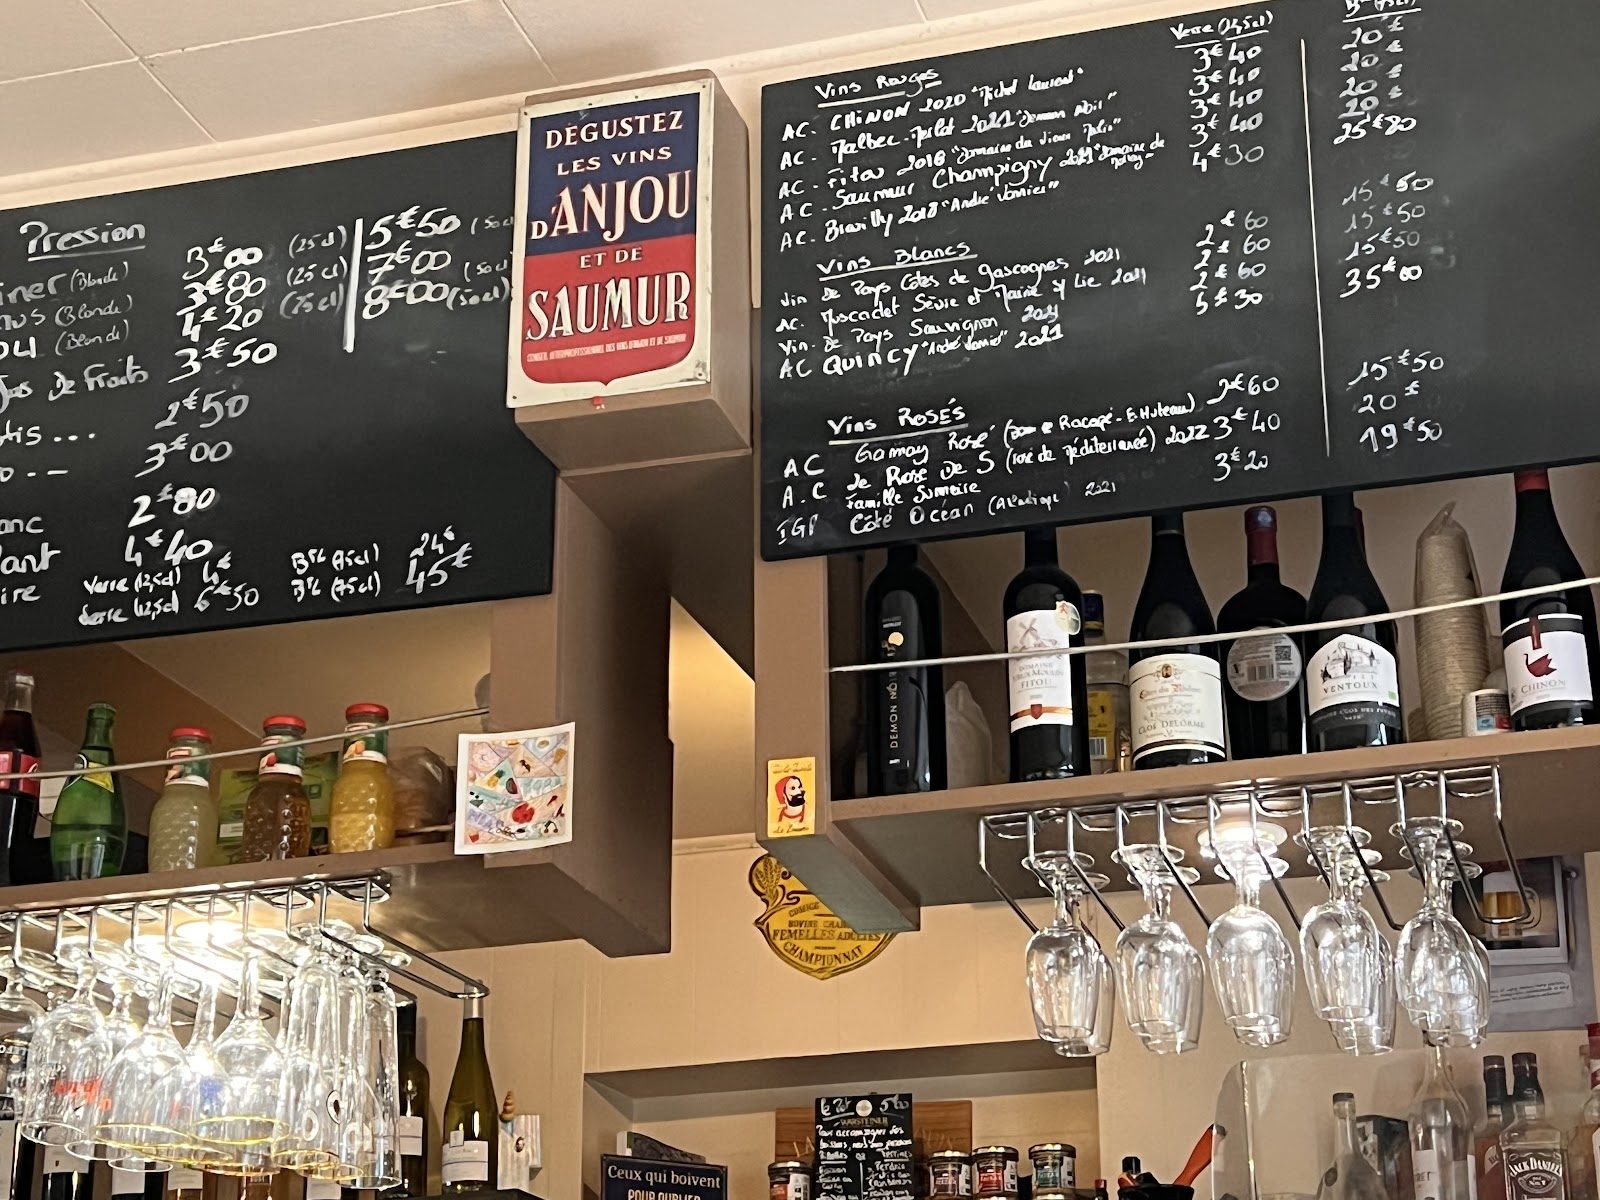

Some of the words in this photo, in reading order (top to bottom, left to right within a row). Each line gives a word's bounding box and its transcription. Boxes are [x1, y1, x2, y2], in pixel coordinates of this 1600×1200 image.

[815, 82, 861, 99] Vins
[919, 94, 966, 113] 2020
[545, 109, 684, 150] DÉGUSTEZ
[556, 152, 601, 176] LES
[611, 145, 673, 167] VINS
[832, 183, 915, 211] Saumur
[932, 155, 1053, 189] Champigny
[530, 169, 692, 243] D'ANJOU
[898, 202, 939, 225] 2018
[19, 220, 146, 255] Pression
[579, 251, 607, 269] ET
[615, 246, 644, 265] DE
[816, 255, 871, 275] Vins
[894, 241, 971, 266] Blancs
[1084, 247, 1121, 266] 2021
[525, 271, 692, 342] SAUMUR
[778, 358, 813, 380] AC
[1014, 323, 1064, 349] 2021
[827, 415, 877, 436] Vins
[976, 449, 996, 475] S
[1323, 682, 1378, 695] VENTOUX
[1520, 678, 1567, 694] CHINON
[889, 704, 899, 749] DEMON
[773, 929, 836, 941] FEMELLES
[783, 941, 864, 967] CHAMPIONNAT
[607, 1165, 642, 1181] Ceux
[645, 1169, 667, 1186] qui
[671, 1171, 721, 1189] boivent
